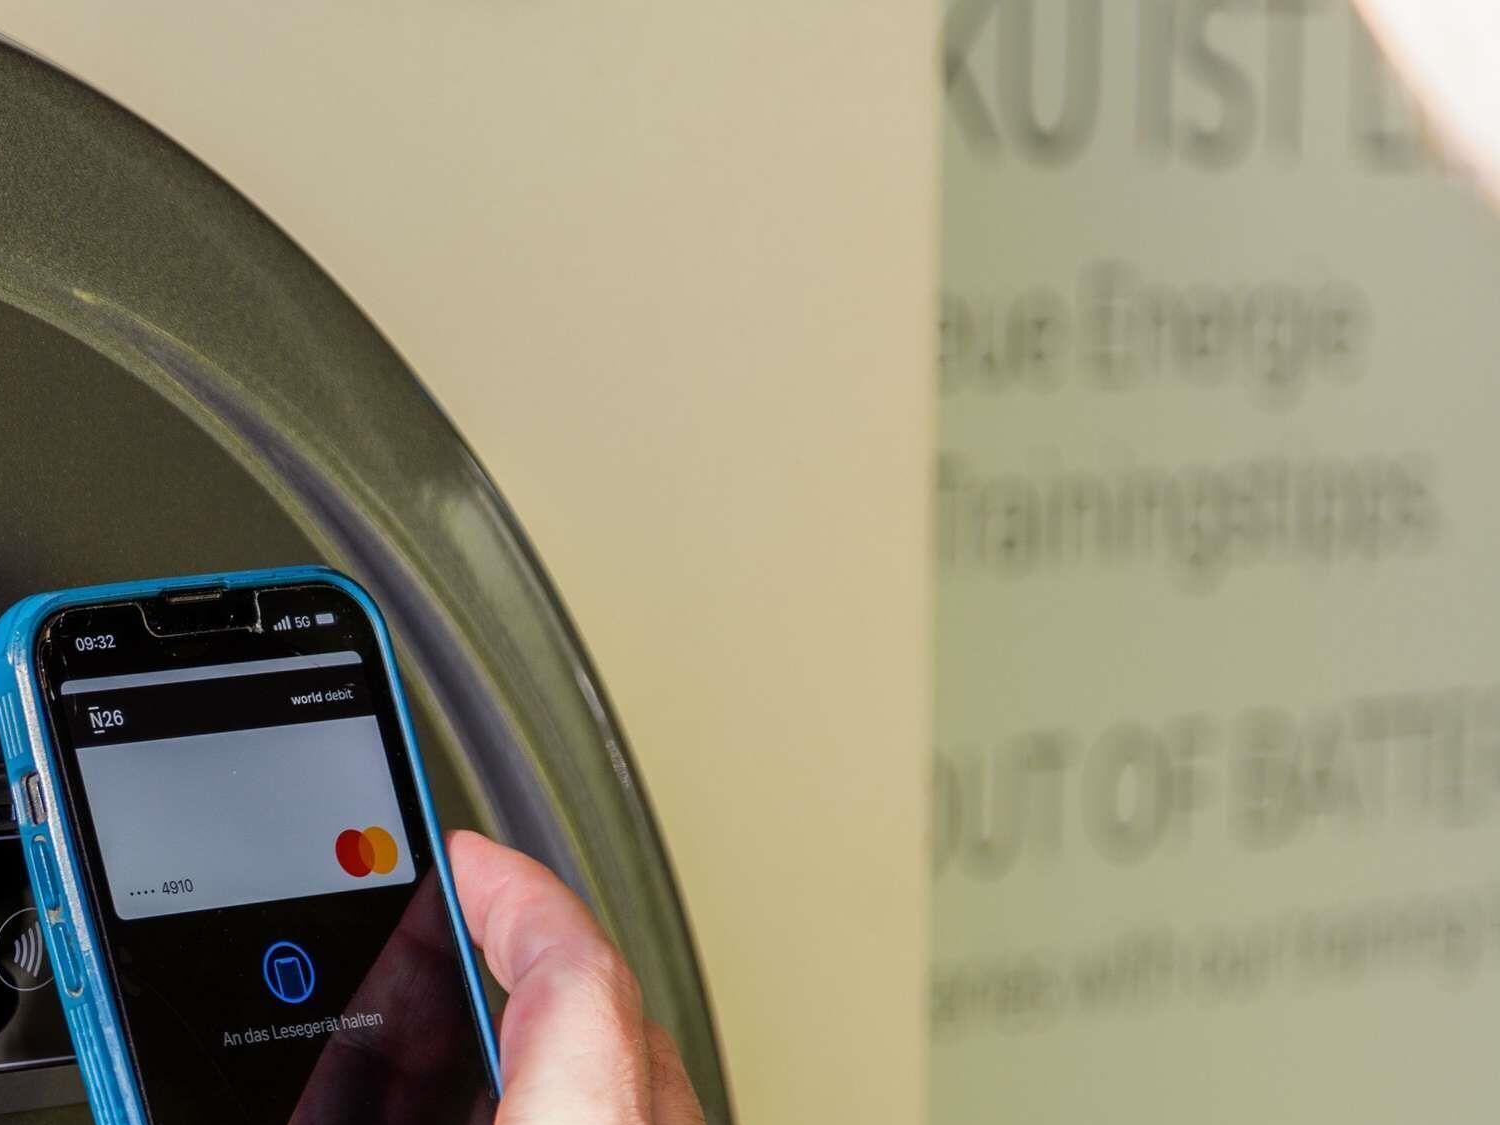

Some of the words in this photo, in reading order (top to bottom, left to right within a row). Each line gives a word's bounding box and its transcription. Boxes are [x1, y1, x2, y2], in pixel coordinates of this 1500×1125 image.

[1077, 258, 1372, 413] Energie
[75, 633, 117, 652] 09:32
[294, 615, 311, 629] 5G
[88, 706, 125, 734] N26
[290, 690, 323, 706] world
[324, 687, 355, 702] debit
[161, 878, 194, 896] 4910
[223, 1031, 243, 1047] An
[244, 1026, 270, 1044] das
[271, 1016, 340, 1040] Lesegerät
[341, 1012, 384, 1030] halten
